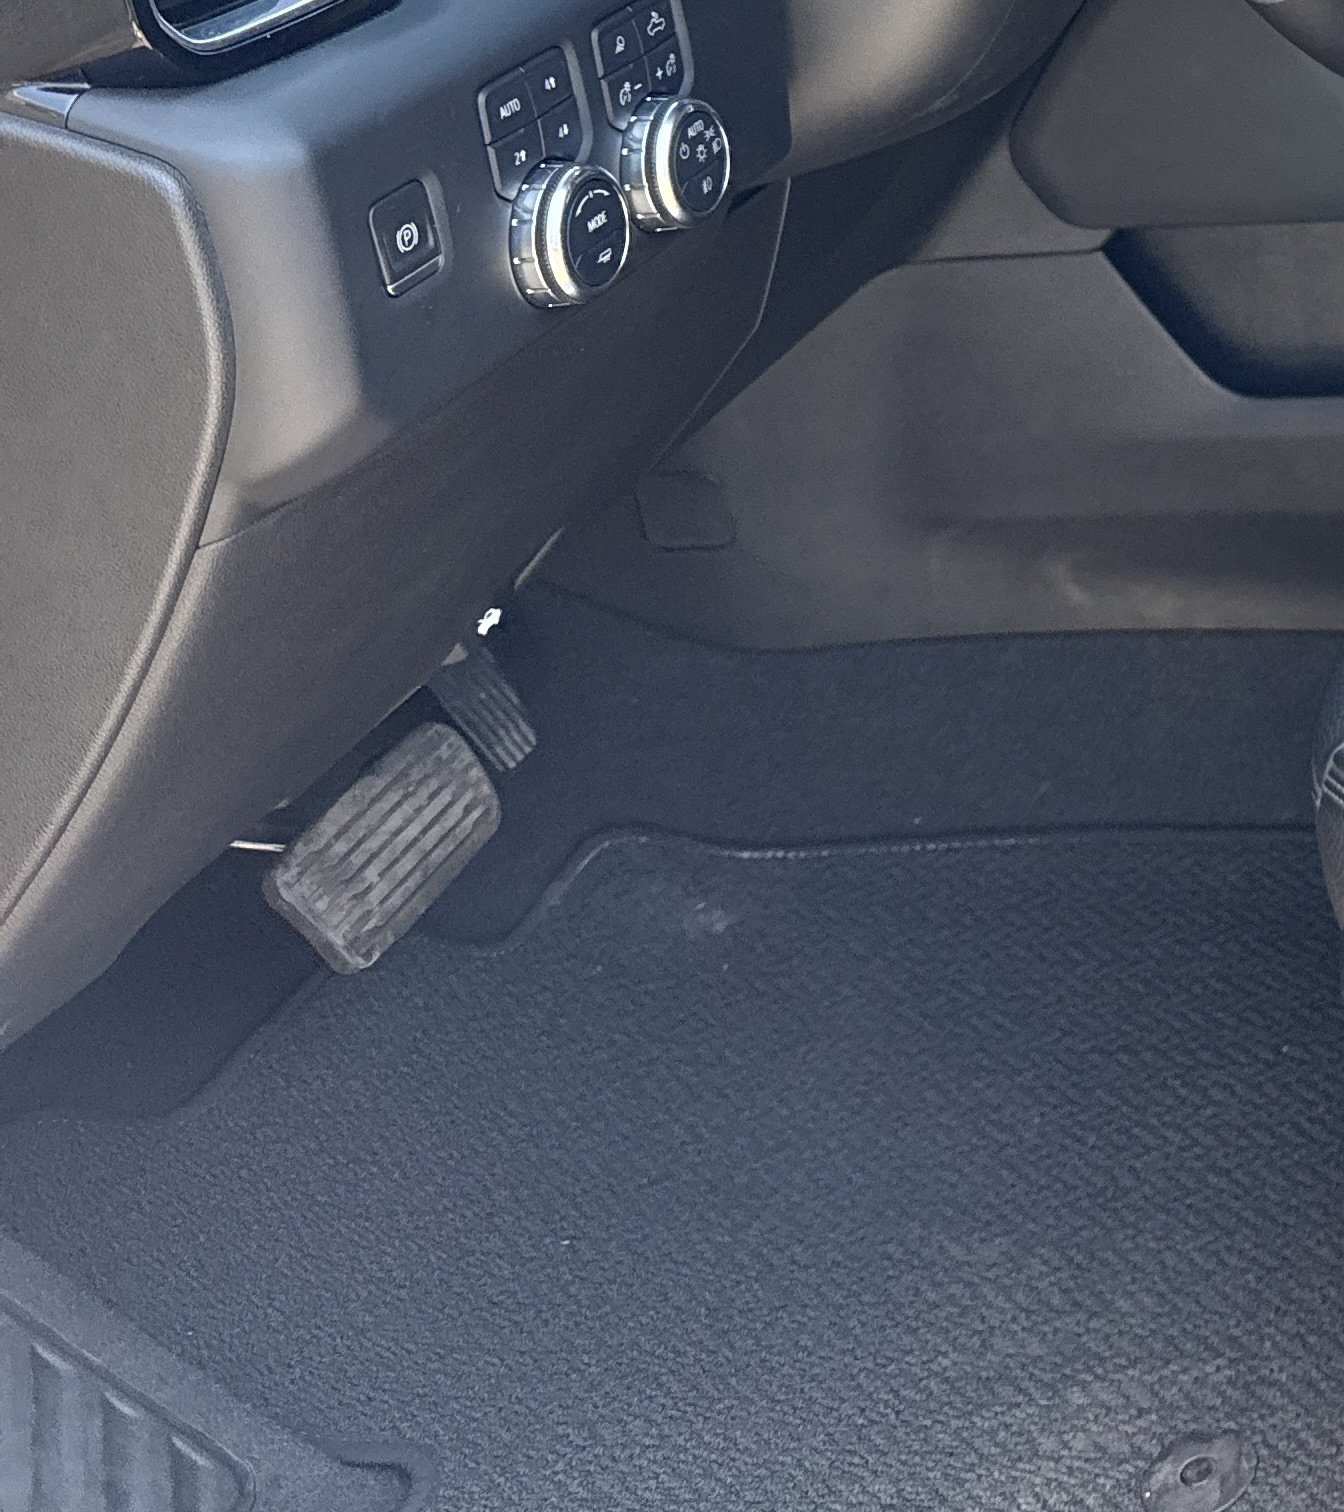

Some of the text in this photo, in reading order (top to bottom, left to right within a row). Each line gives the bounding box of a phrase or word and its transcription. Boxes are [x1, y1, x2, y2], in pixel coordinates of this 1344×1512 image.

[499, 98, 521, 120] AUTO
[687, 119, 705, 139] AUTO
[587, 210, 608, 233] MODE
